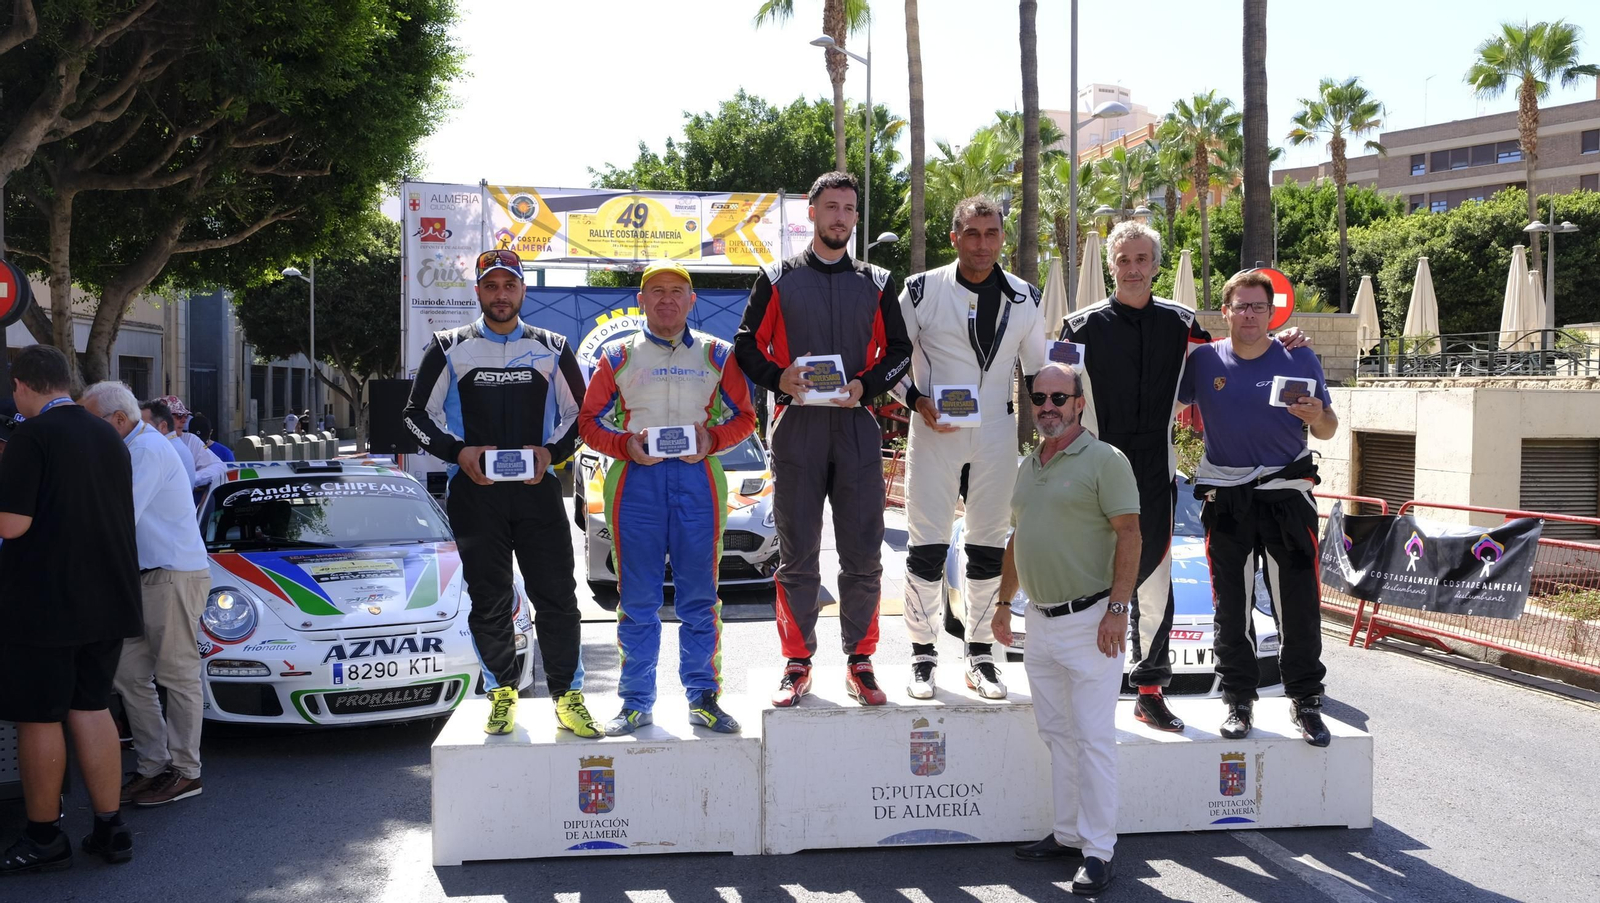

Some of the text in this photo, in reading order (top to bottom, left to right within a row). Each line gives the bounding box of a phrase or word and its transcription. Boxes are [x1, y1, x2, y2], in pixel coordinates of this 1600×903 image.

[430, 194, 479, 204] ALMERÍA
[616, 203, 648, 229] 49
[589, 229, 682, 240] RALLYE COSTA DE ALMERÍA
[510, 243, 553, 253] ALMERÍA
[416, 258, 469, 289] Enix
[411, 298, 477, 306] Diario de Almería
[582, 318, 645, 359] AUTOMOVI
[474, 370, 533, 382] ASTARS
[404, 416, 431, 446] ASTARS
[250, 482, 417, 498] André CHIPEAUX
[250, 489, 366, 502] MOTOR CONCEPT
[242, 644, 297, 652] frionature
[323, 637, 443, 664] AZNAR
[348, 656, 443, 681] 8290 KTL
[335, 676, 342, 684] E
[335, 686, 434, 707] PRORALLYE
[873, 799, 982, 820] DE ALMERÍA
[1208, 798, 1256, 808] DIPUTACIÓN
[1210, 807, 1255, 817] DE ALMERÍA
[563, 817, 629, 830] DIPUTACIÓN
[565, 828, 628, 841] DE ALMERÍA
